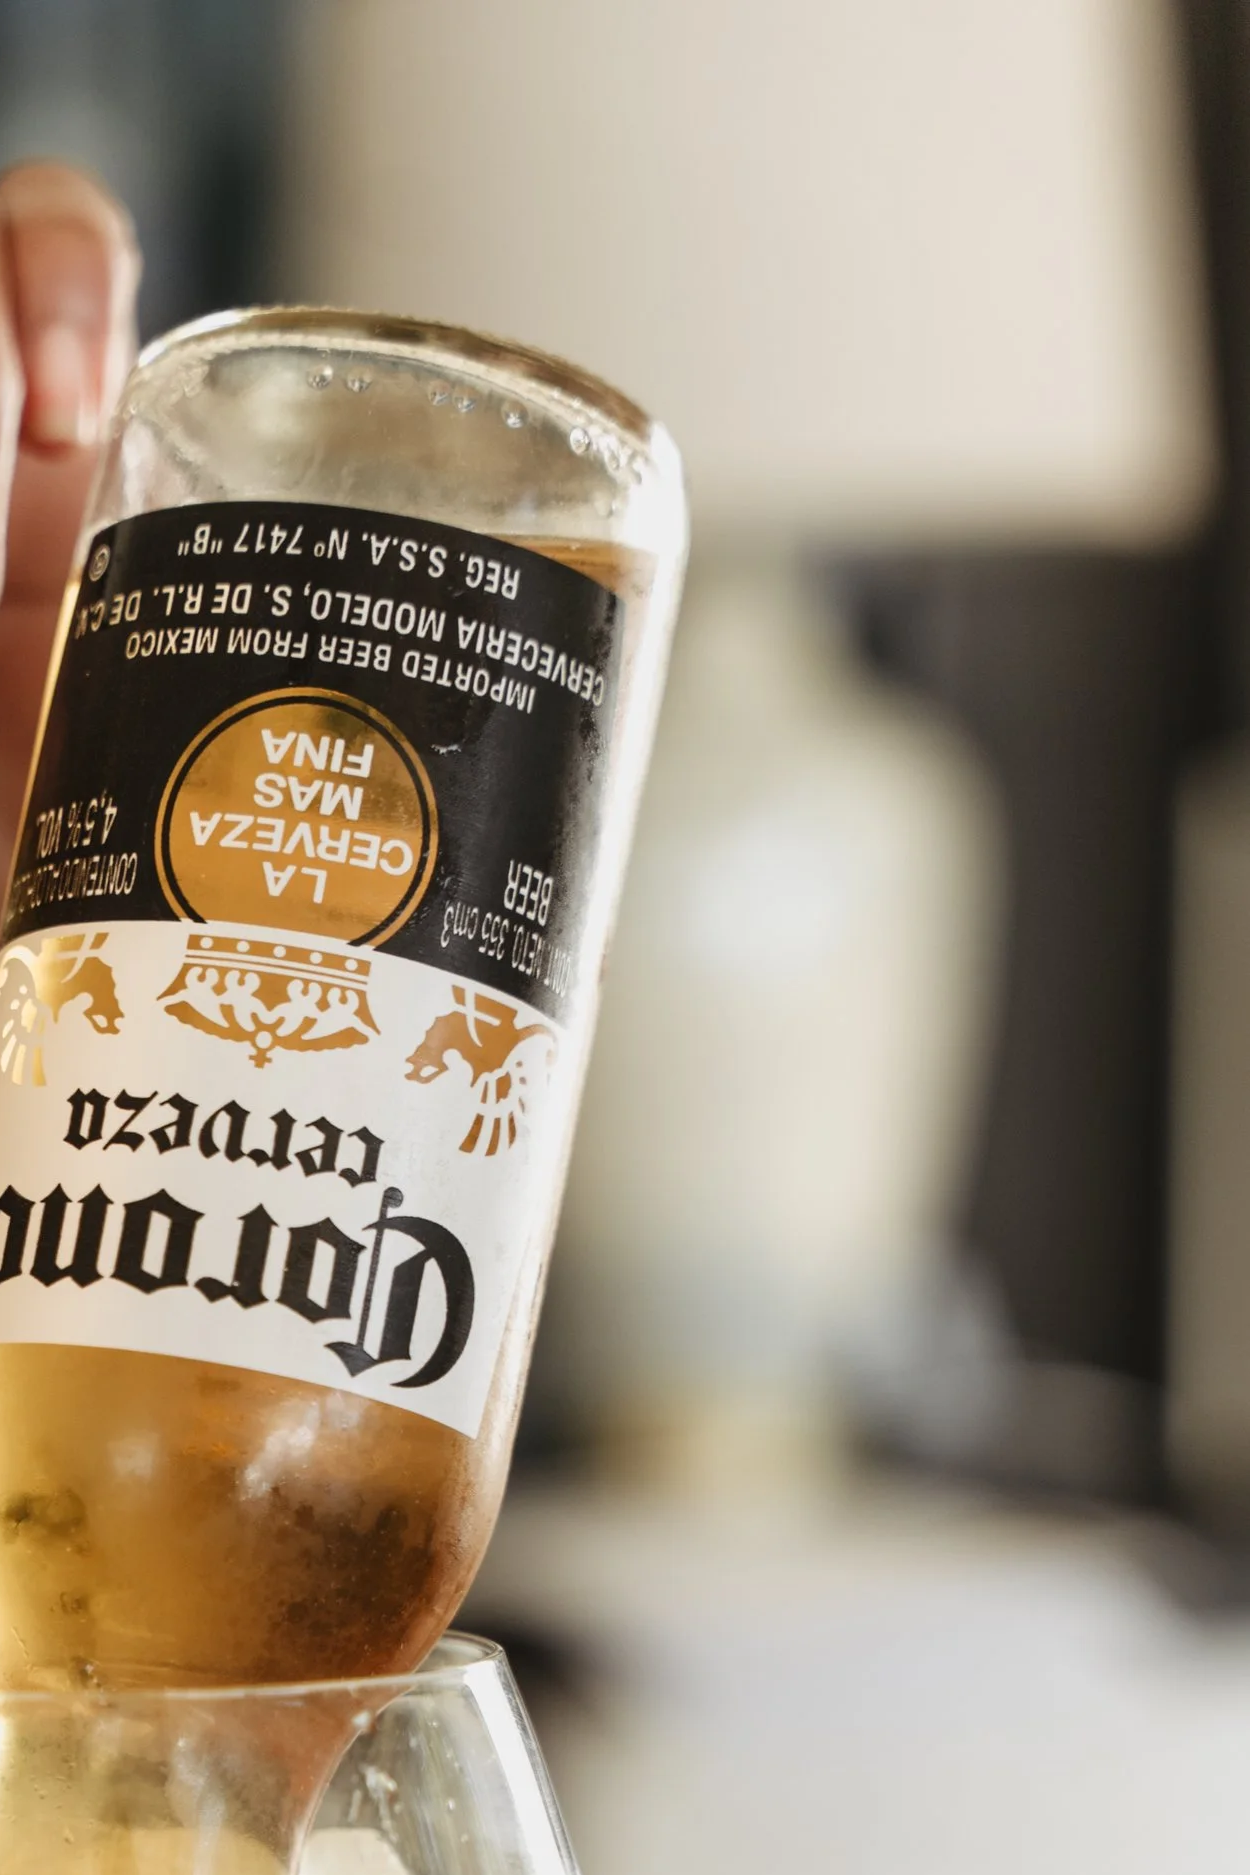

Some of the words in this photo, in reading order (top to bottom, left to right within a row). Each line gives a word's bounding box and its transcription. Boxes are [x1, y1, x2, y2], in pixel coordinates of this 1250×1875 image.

[234, 524, 303, 554] 7417
[363, 534, 447, 577] S.S.A.
[211, 584, 252, 613] DE
[460, 554, 519, 600] REG.
[110, 591, 141, 625] DE
[154, 585, 203, 615] R.L.
[265, 585, 291, 616] S.
[304, 583, 445, 641] MODELO,
[126, 628, 218, 659] MEXICO
[227, 628, 308, 658] FROM
[319, 636, 391, 671] BEER
[458, 617, 607, 709] CERVECERIA
[402, 651, 535, 713] IMPORTED
[262, 729, 374, 777] FINA
[253, 774, 363, 820] MAS
[190, 812, 413, 875] CERVEZA
[263, 862, 327, 903] LA
[504, 859, 553, 926] BEER
[478, 912, 507, 960] 355
[63, 1089, 384, 1187] cerveza
